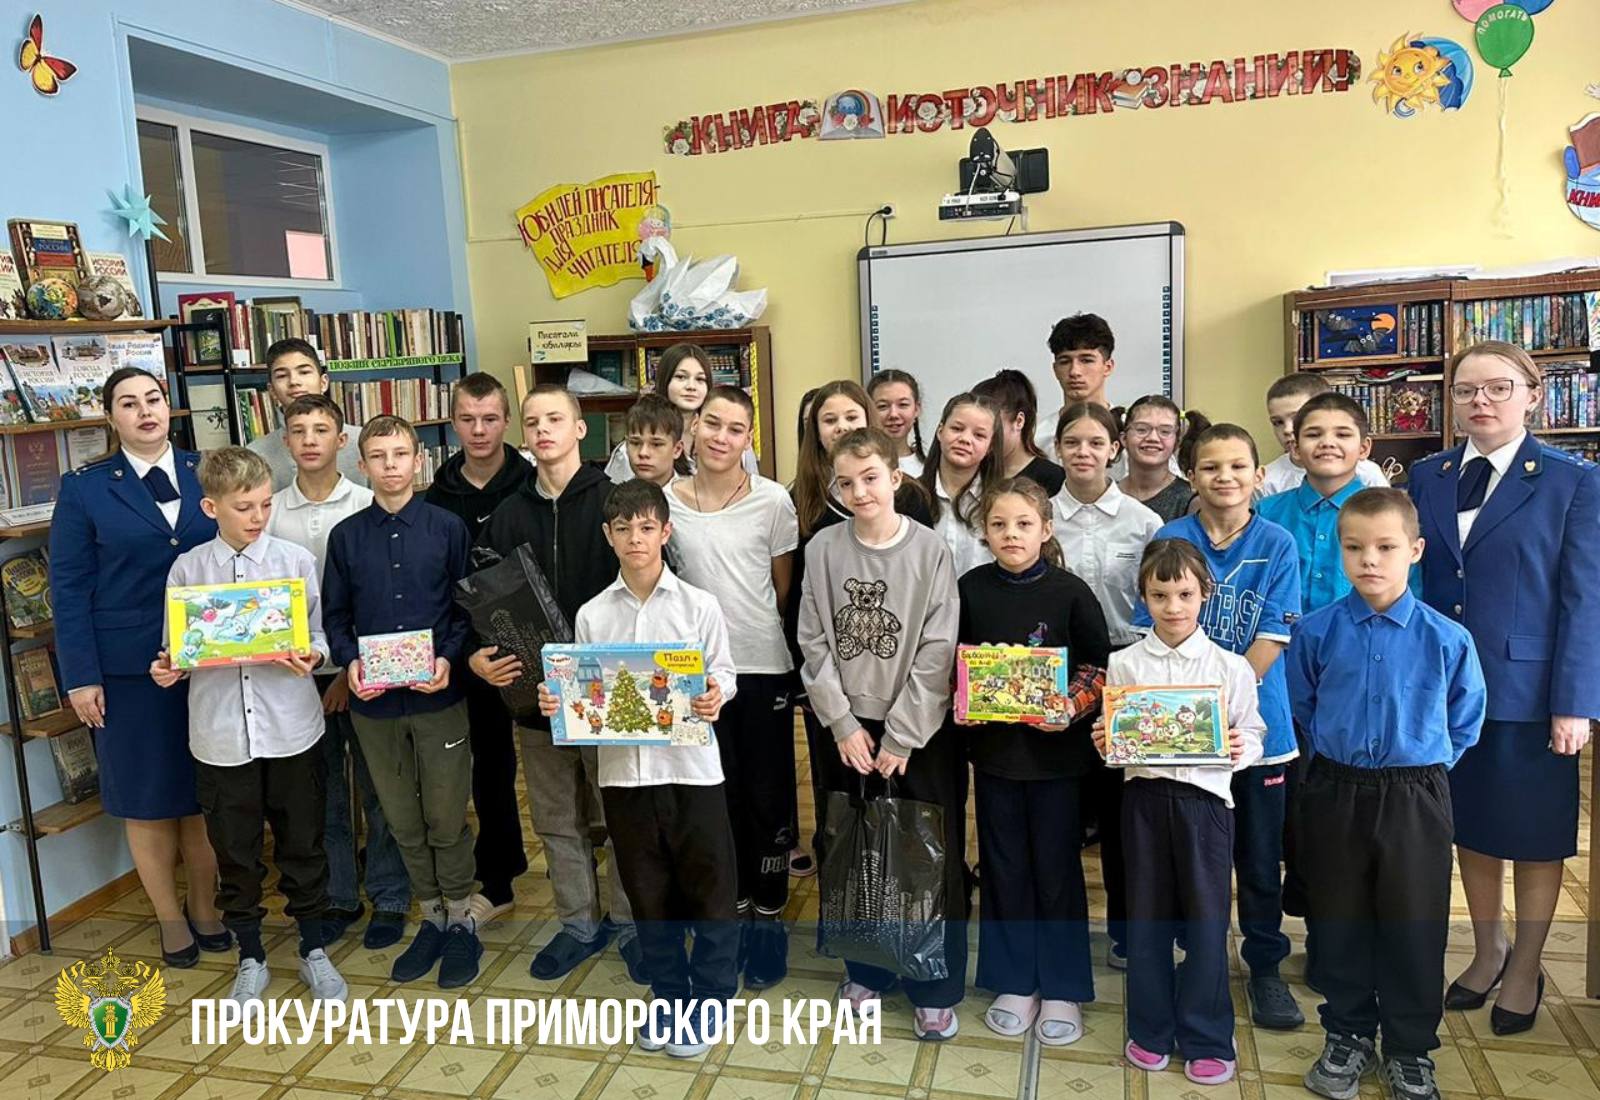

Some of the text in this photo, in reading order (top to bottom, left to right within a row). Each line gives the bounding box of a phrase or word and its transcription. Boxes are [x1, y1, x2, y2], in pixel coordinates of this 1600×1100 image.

[1476, 9, 1529, 35] ПОМОГАТЬ
[691, 99, 812, 155] КНИГА
[887, 71, 1114, 134] ИСТОЧНИК
[517, 187, 582, 247] ЮБИЛЕЙ
[549, 210, 619, 246] ПРАЗДНИК
[544, 237, 576, 275] ДЛЯ
